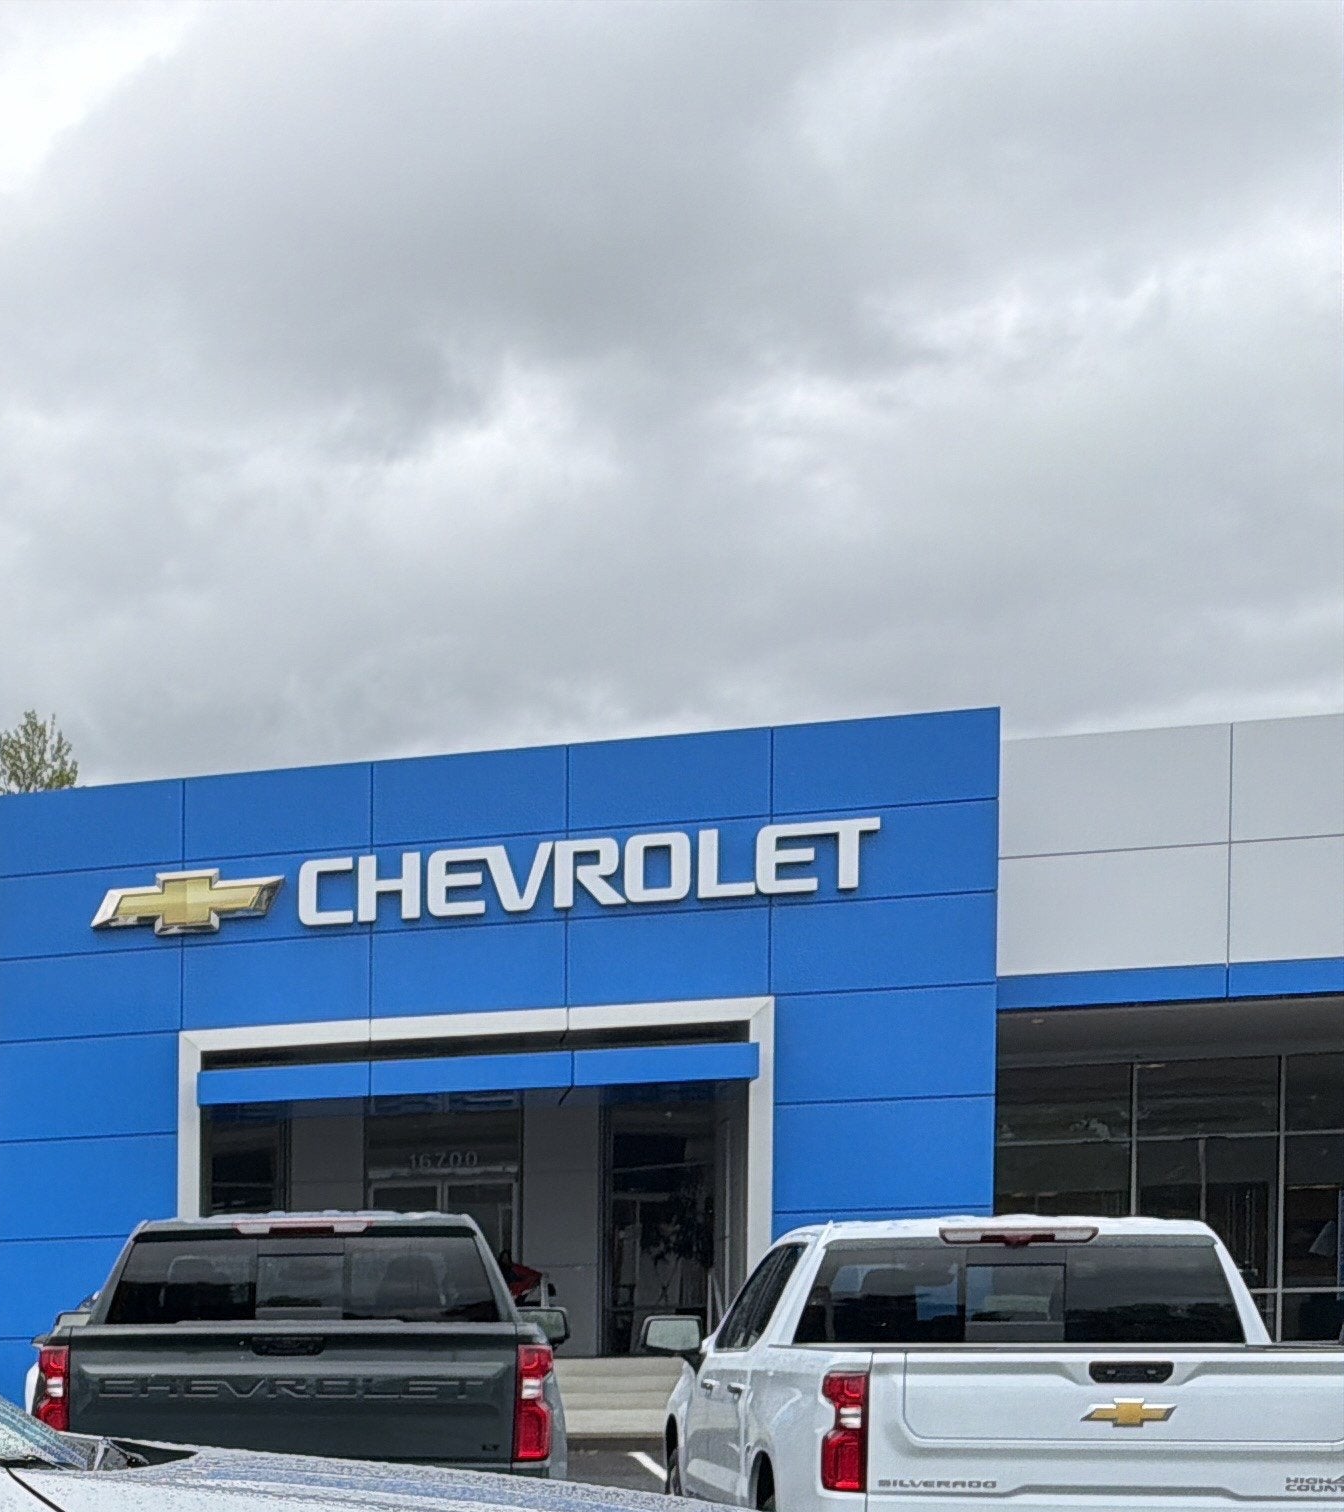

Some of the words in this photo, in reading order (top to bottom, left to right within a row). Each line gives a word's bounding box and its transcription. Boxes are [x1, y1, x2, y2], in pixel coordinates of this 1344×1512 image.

[297, 816, 881, 926] CHEVROLET
[409, 1150, 478, 1169] 16700
[97, 1377, 485, 1399] CHEVROLET
[878, 1479, 997, 1489] SILVERADO
